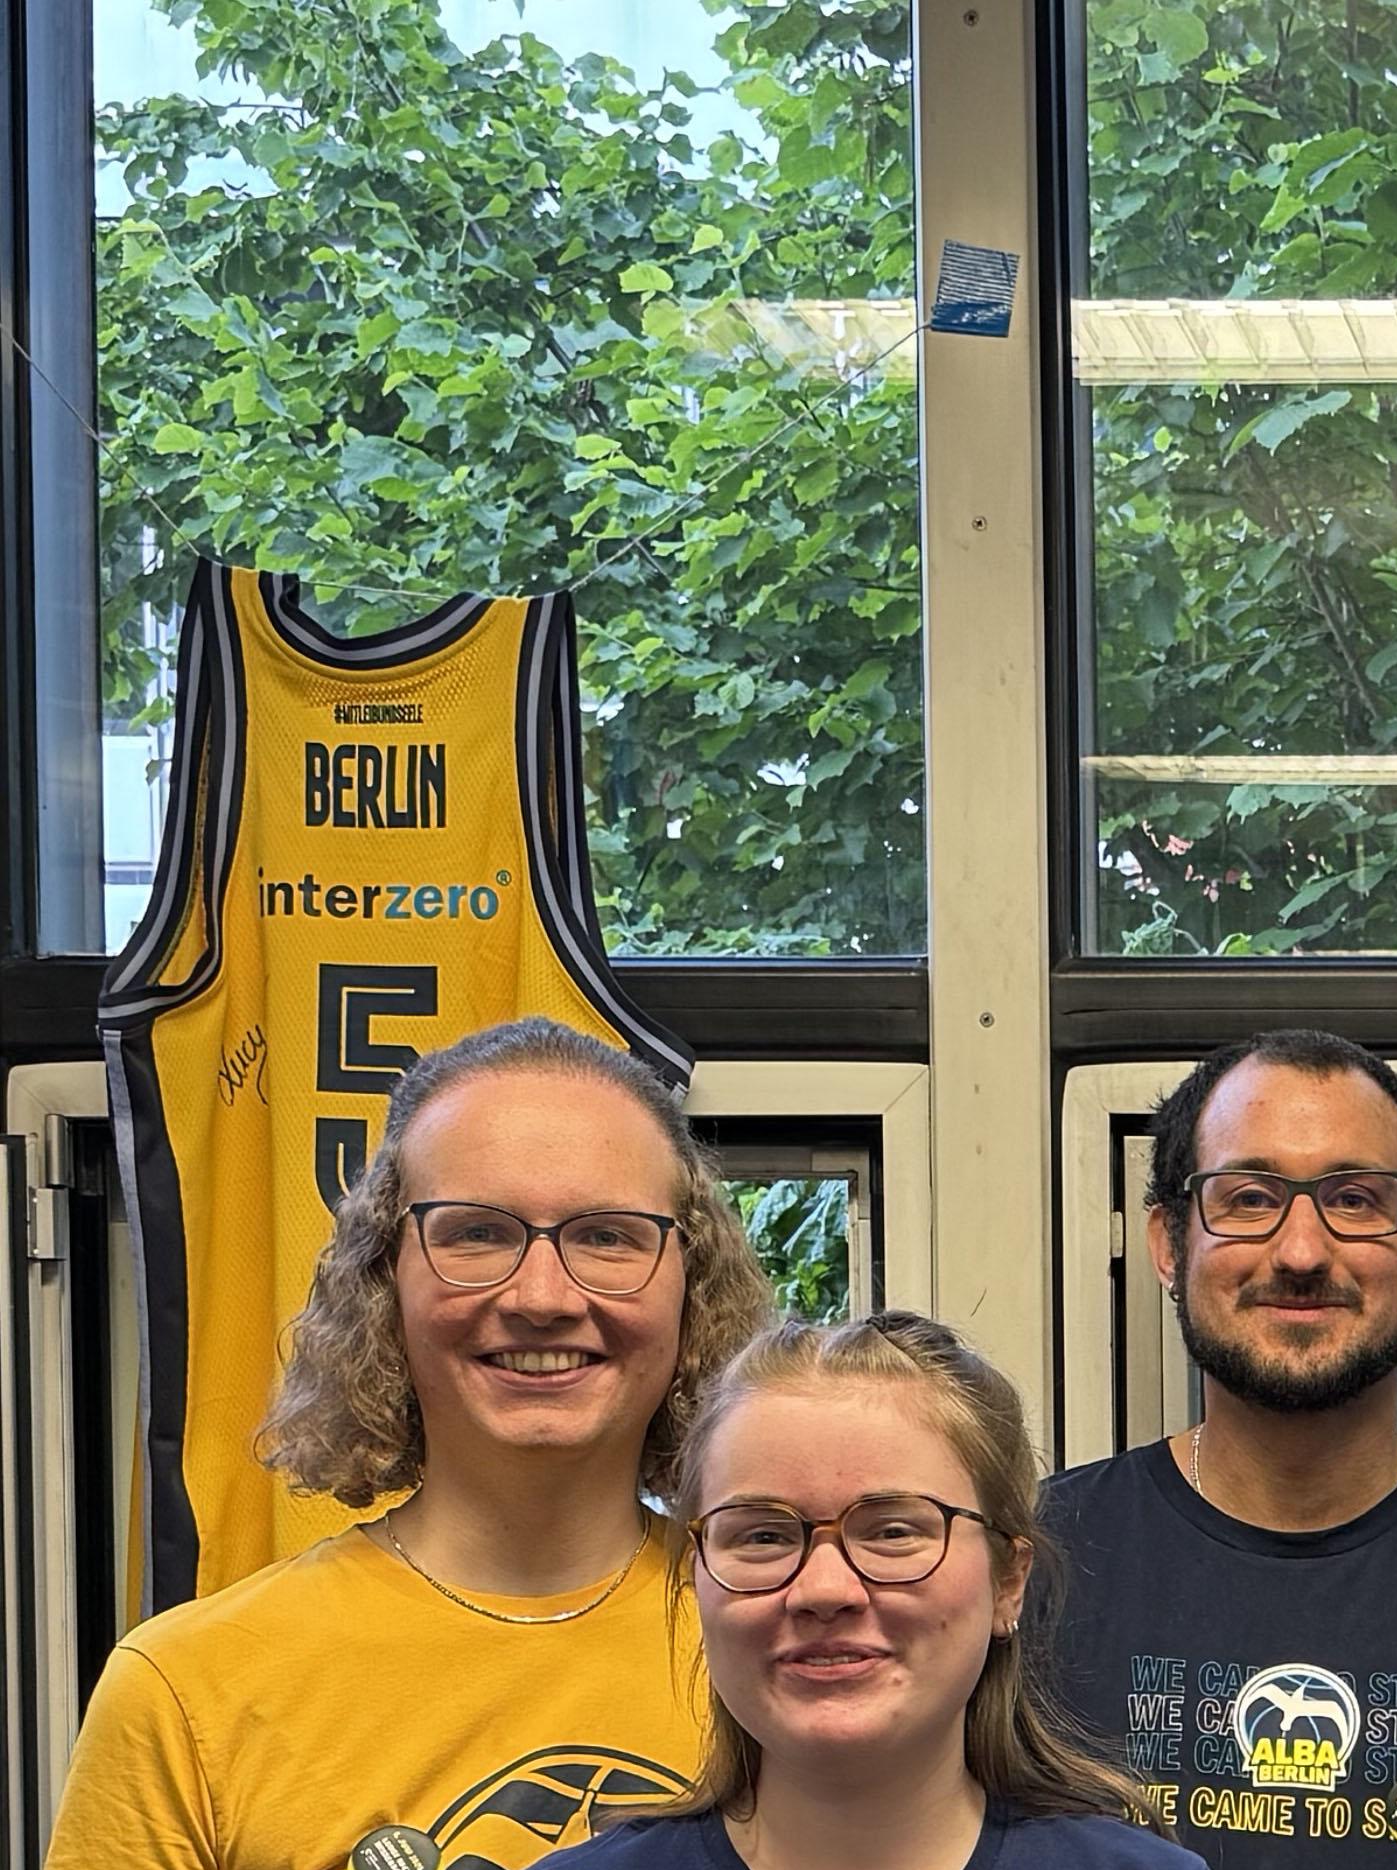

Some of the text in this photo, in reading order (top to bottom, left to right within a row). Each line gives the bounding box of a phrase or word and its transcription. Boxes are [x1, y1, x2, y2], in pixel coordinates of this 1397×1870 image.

[305, 741, 446, 829] BERLIN
[1131, 1656, 1186, 1694] WE
[1198, 1661, 1260, 1698] CA
[1128, 1694, 1184, 1731] WE
[1126, 1732, 1182, 1770] WE
[1251, 1737, 1339, 1770] ALBA
[1259, 1765, 1331, 1785] BERLIN
[1190, 1786, 1296, 1836] CAME
[1306, 1798, 1352, 1838] TO
